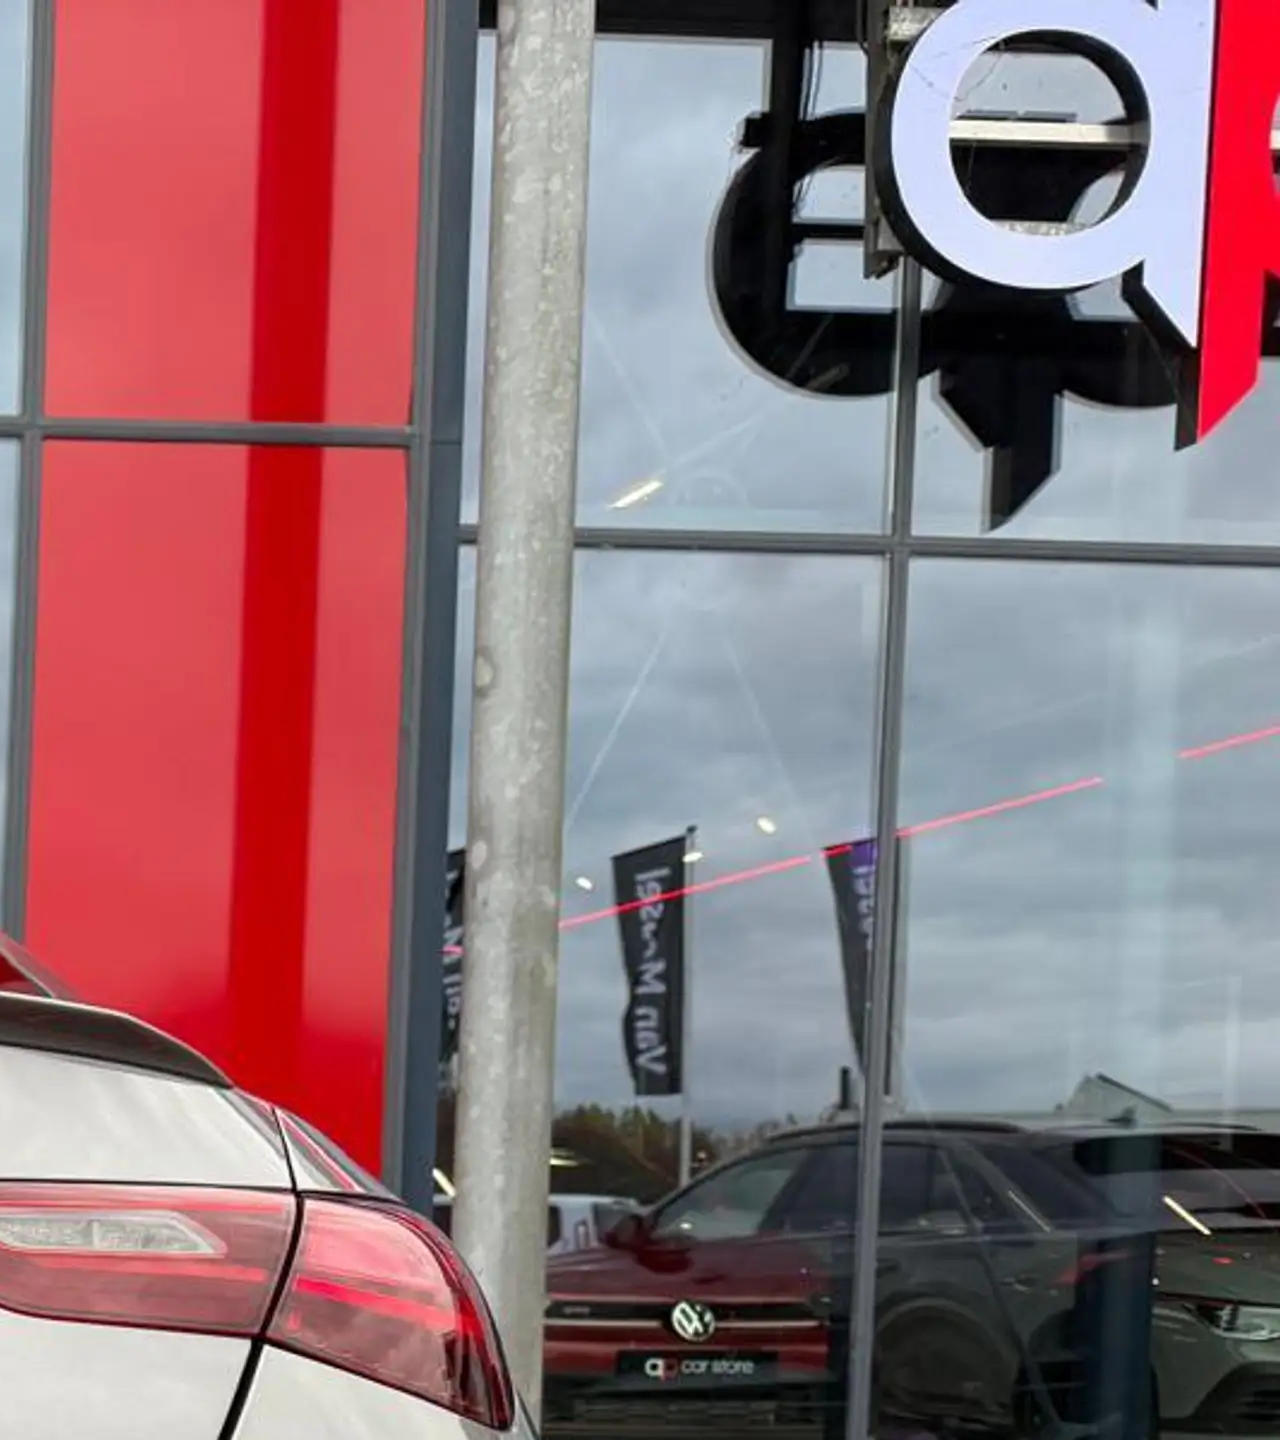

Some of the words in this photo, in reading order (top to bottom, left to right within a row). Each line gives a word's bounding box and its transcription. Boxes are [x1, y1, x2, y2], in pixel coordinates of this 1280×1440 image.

[890, 0, 1280, 445] a
[680, 1359, 711, 1375] car
[712, 1358, 754, 1375] store
